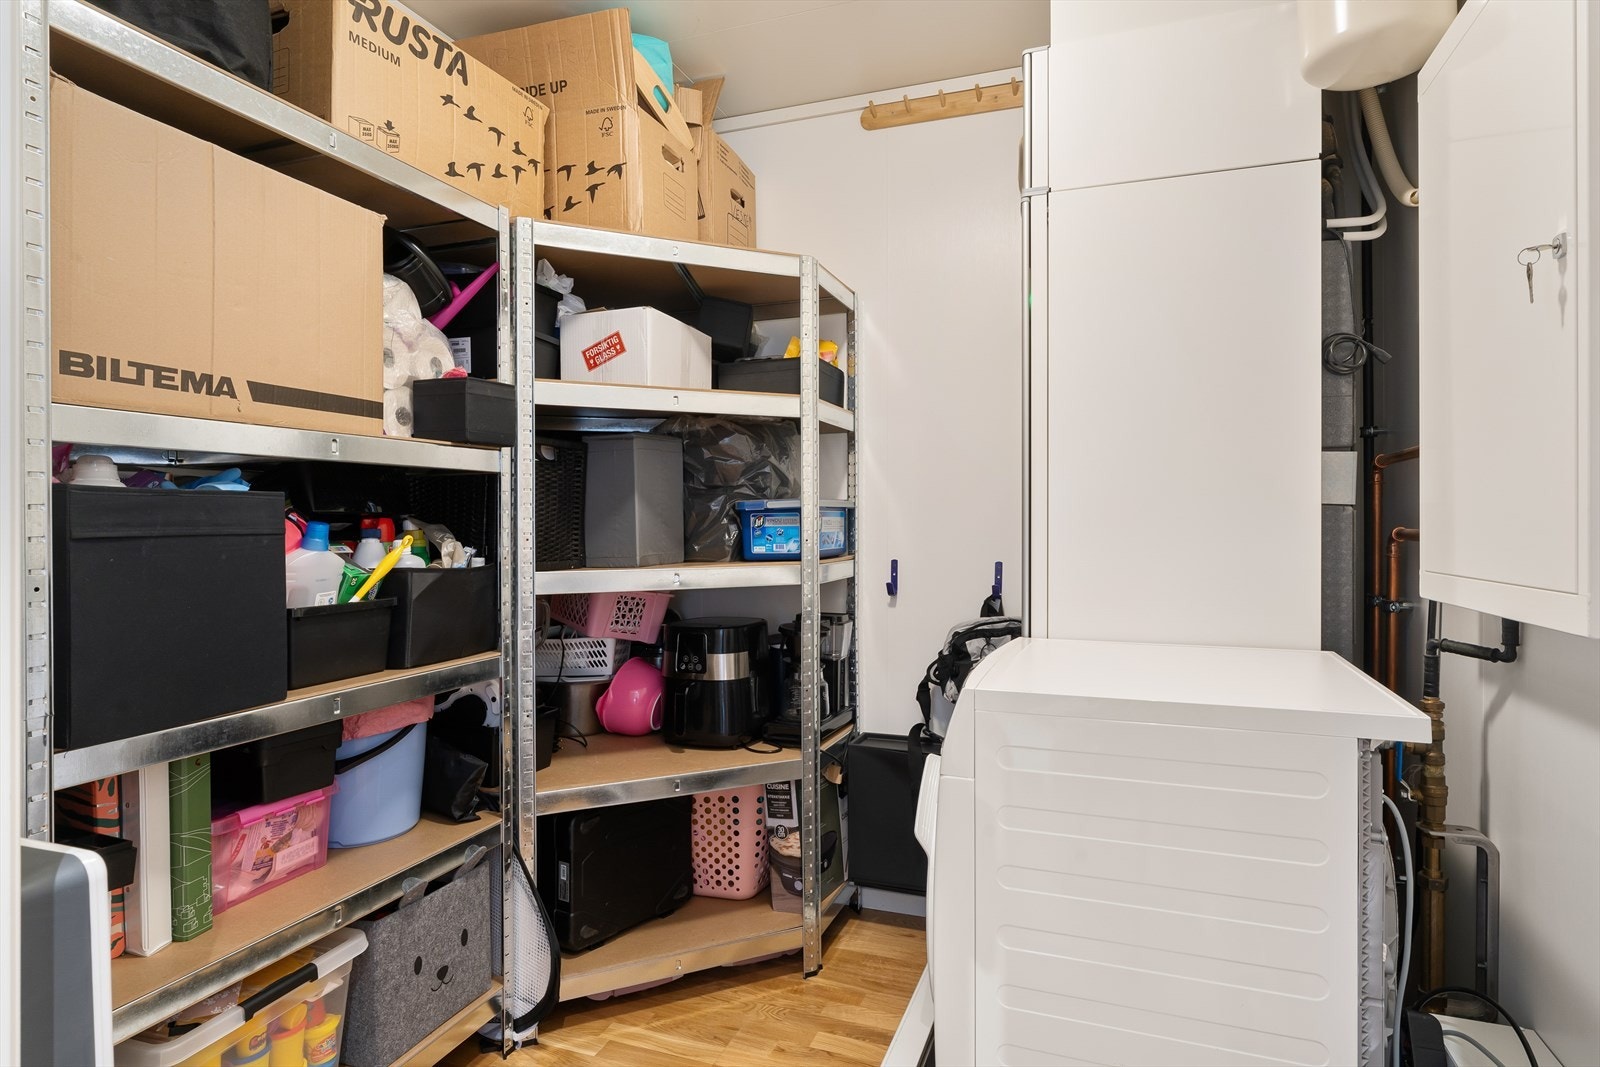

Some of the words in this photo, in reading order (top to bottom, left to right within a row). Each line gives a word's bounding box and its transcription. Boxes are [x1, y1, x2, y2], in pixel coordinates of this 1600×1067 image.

[348, 0, 470, 86] RUSTA
[348, 30, 401, 67] MEDIUM
[520, 83, 546, 97] IDE
[549, 79, 568, 94] UP
[585, 335, 619, 359] FORSIKTIG
[594, 347, 616, 365] GLASS
[58, 349, 238, 400] BILTEMA
